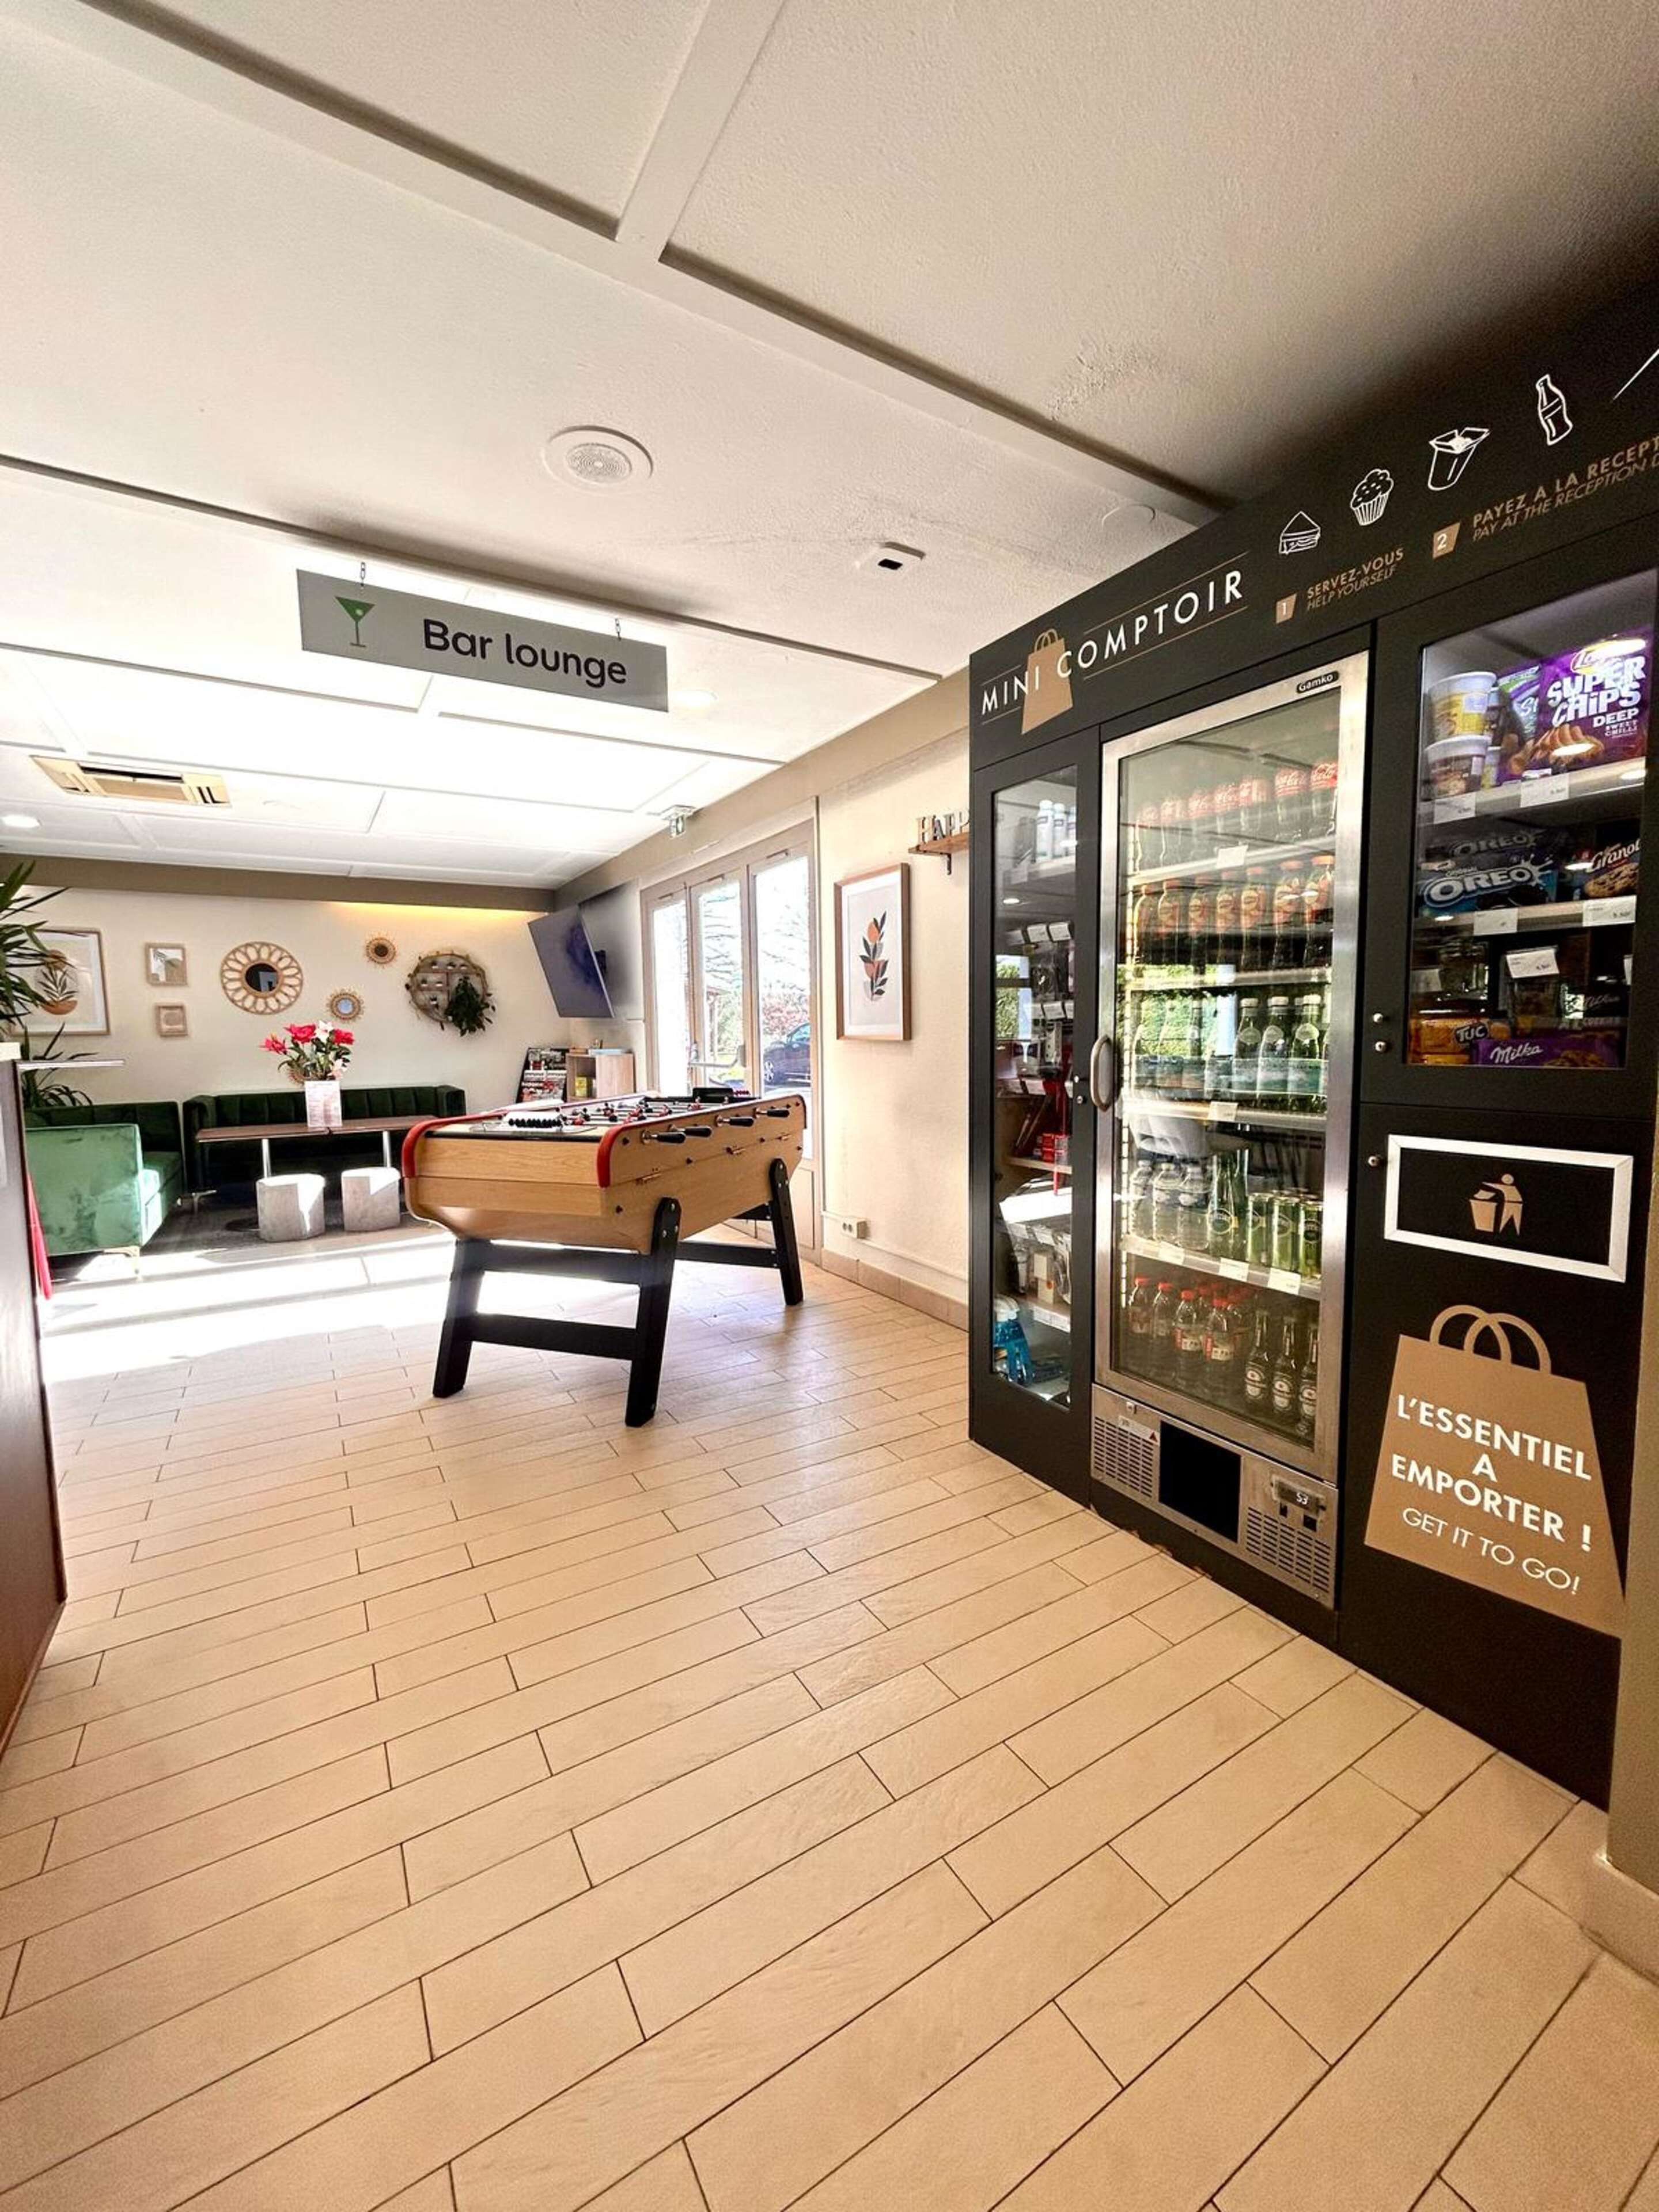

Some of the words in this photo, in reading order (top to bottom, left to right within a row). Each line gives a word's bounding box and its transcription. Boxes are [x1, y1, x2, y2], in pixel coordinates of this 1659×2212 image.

[1472, 521, 1498, 541] PAY
[1501, 512, 1519, 530] AT
[1524, 498, 1552, 521] THE
[1554, 459, 1647, 508] RECEPTION
[1473, 493, 1527, 528] PAYEZ
[1534, 486, 1546, 502] A
[1556, 472, 1578, 493] LA
[1437, 533, 1448, 551] 2
[1307, 548, 1404, 599] SERVEZ-VOUS
[1307, 592, 1334, 611] HELP
[1337, 564, 1397, 599] YOURSELF
[1282, 602, 1287, 615] 1
[423, 619, 493, 660] Bar
[505, 632, 627, 688] lounge
[981, 665, 1040, 715] MINI
[1056, 570, 1243, 678] COMPTOIR
[1298, 673, 1334, 692] Gamko
[1547, 656, 1646, 707] SUPER
[1592, 707, 1639, 728] DEEP
[1453, 834, 1528, 855] OREO
[1429, 867, 1532, 902] OREO
[1456, 1025, 1485, 1042] TUC
[1490, 1042, 1543, 1065] Milka
[1397, 1394, 1592, 1481] L'ESSENTIEL
[1472, 1453, 1498, 1482] A
[1392, 1453, 1565, 1543] EMPORTER
[1402, 1508, 1448, 1537] GET
[1452, 1527, 1474, 1548] IT
[1480, 1537, 1515, 1566] TO
[1522, 1558, 1581, 1595] GO!
